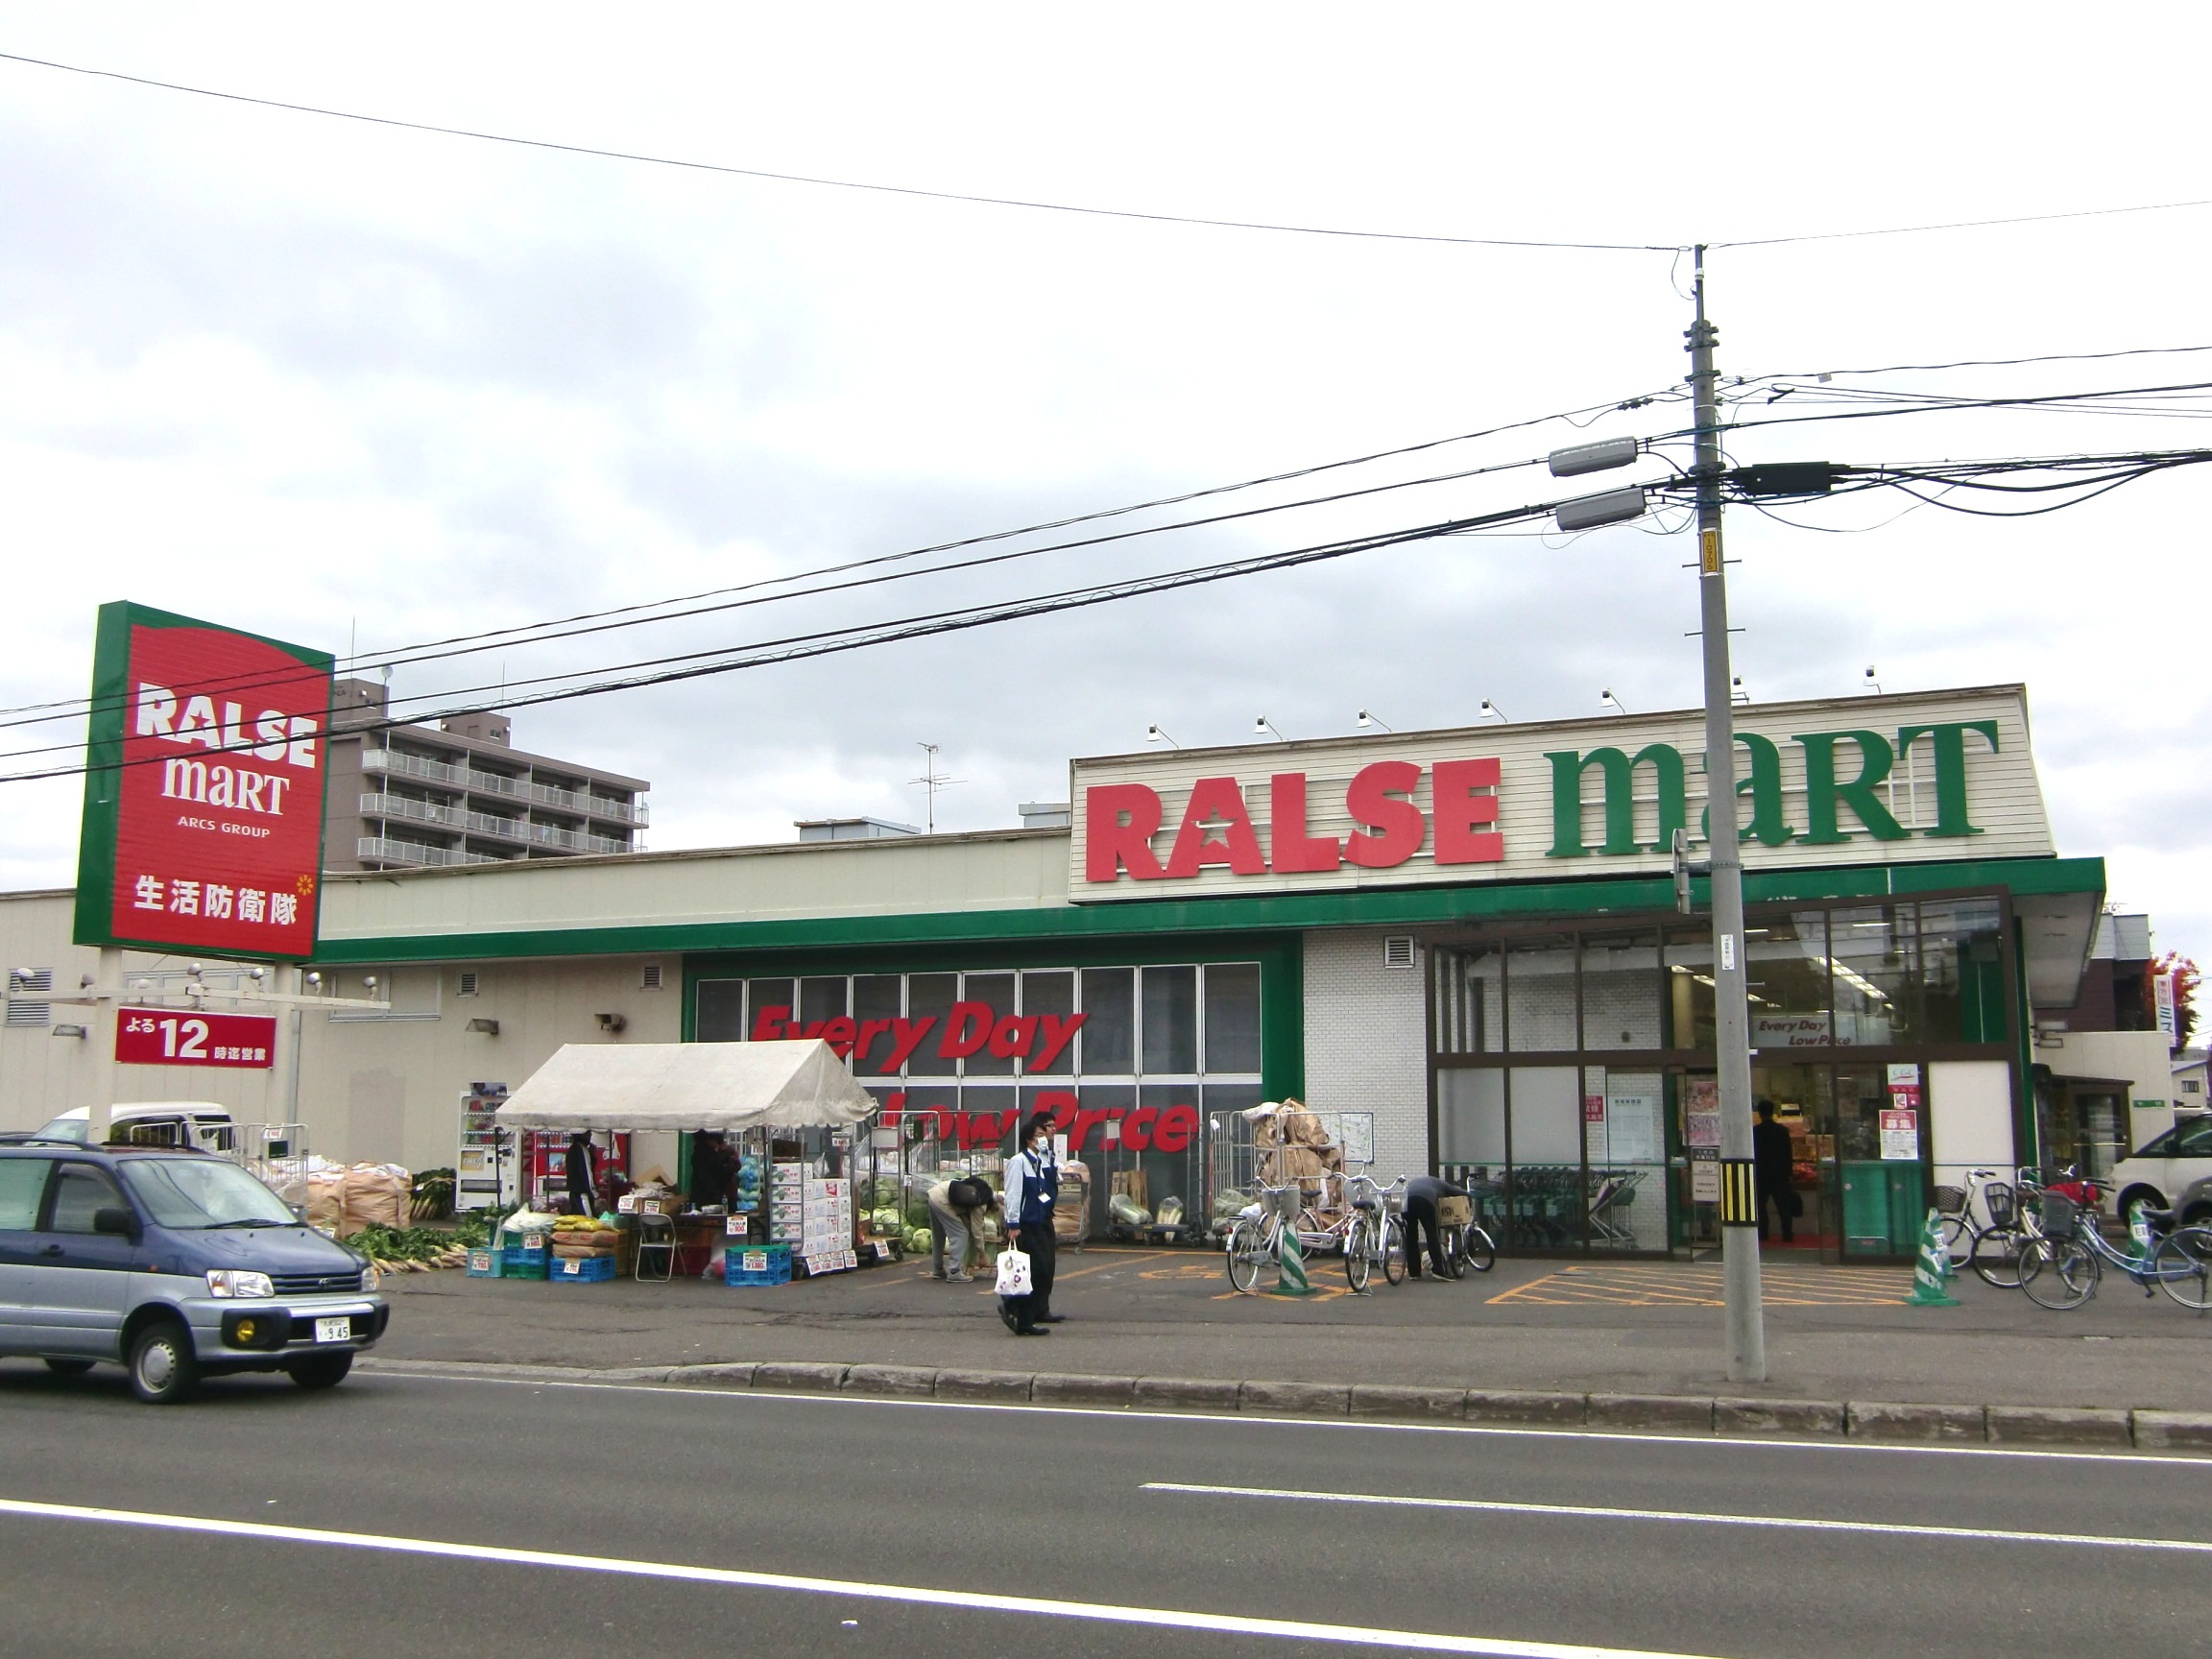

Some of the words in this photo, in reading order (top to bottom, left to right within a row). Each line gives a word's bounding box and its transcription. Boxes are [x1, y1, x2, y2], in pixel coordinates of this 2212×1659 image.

[137, 683, 317, 768] RALSE
[178, 816, 216, 831] ARCS
[221, 822, 271, 838] GROUP
[1086, 757, 1504, 883] RALSE
[133, 875, 298, 926] 生活防衛隊
[752, 1005, 937, 1072] Every
[937, 1001, 1089, 1071] Day
[1759, 1020, 1798, 1033] Every
[1798, 1020, 1827, 1032] Day
[1789, 1035, 1817, 1046] Low
